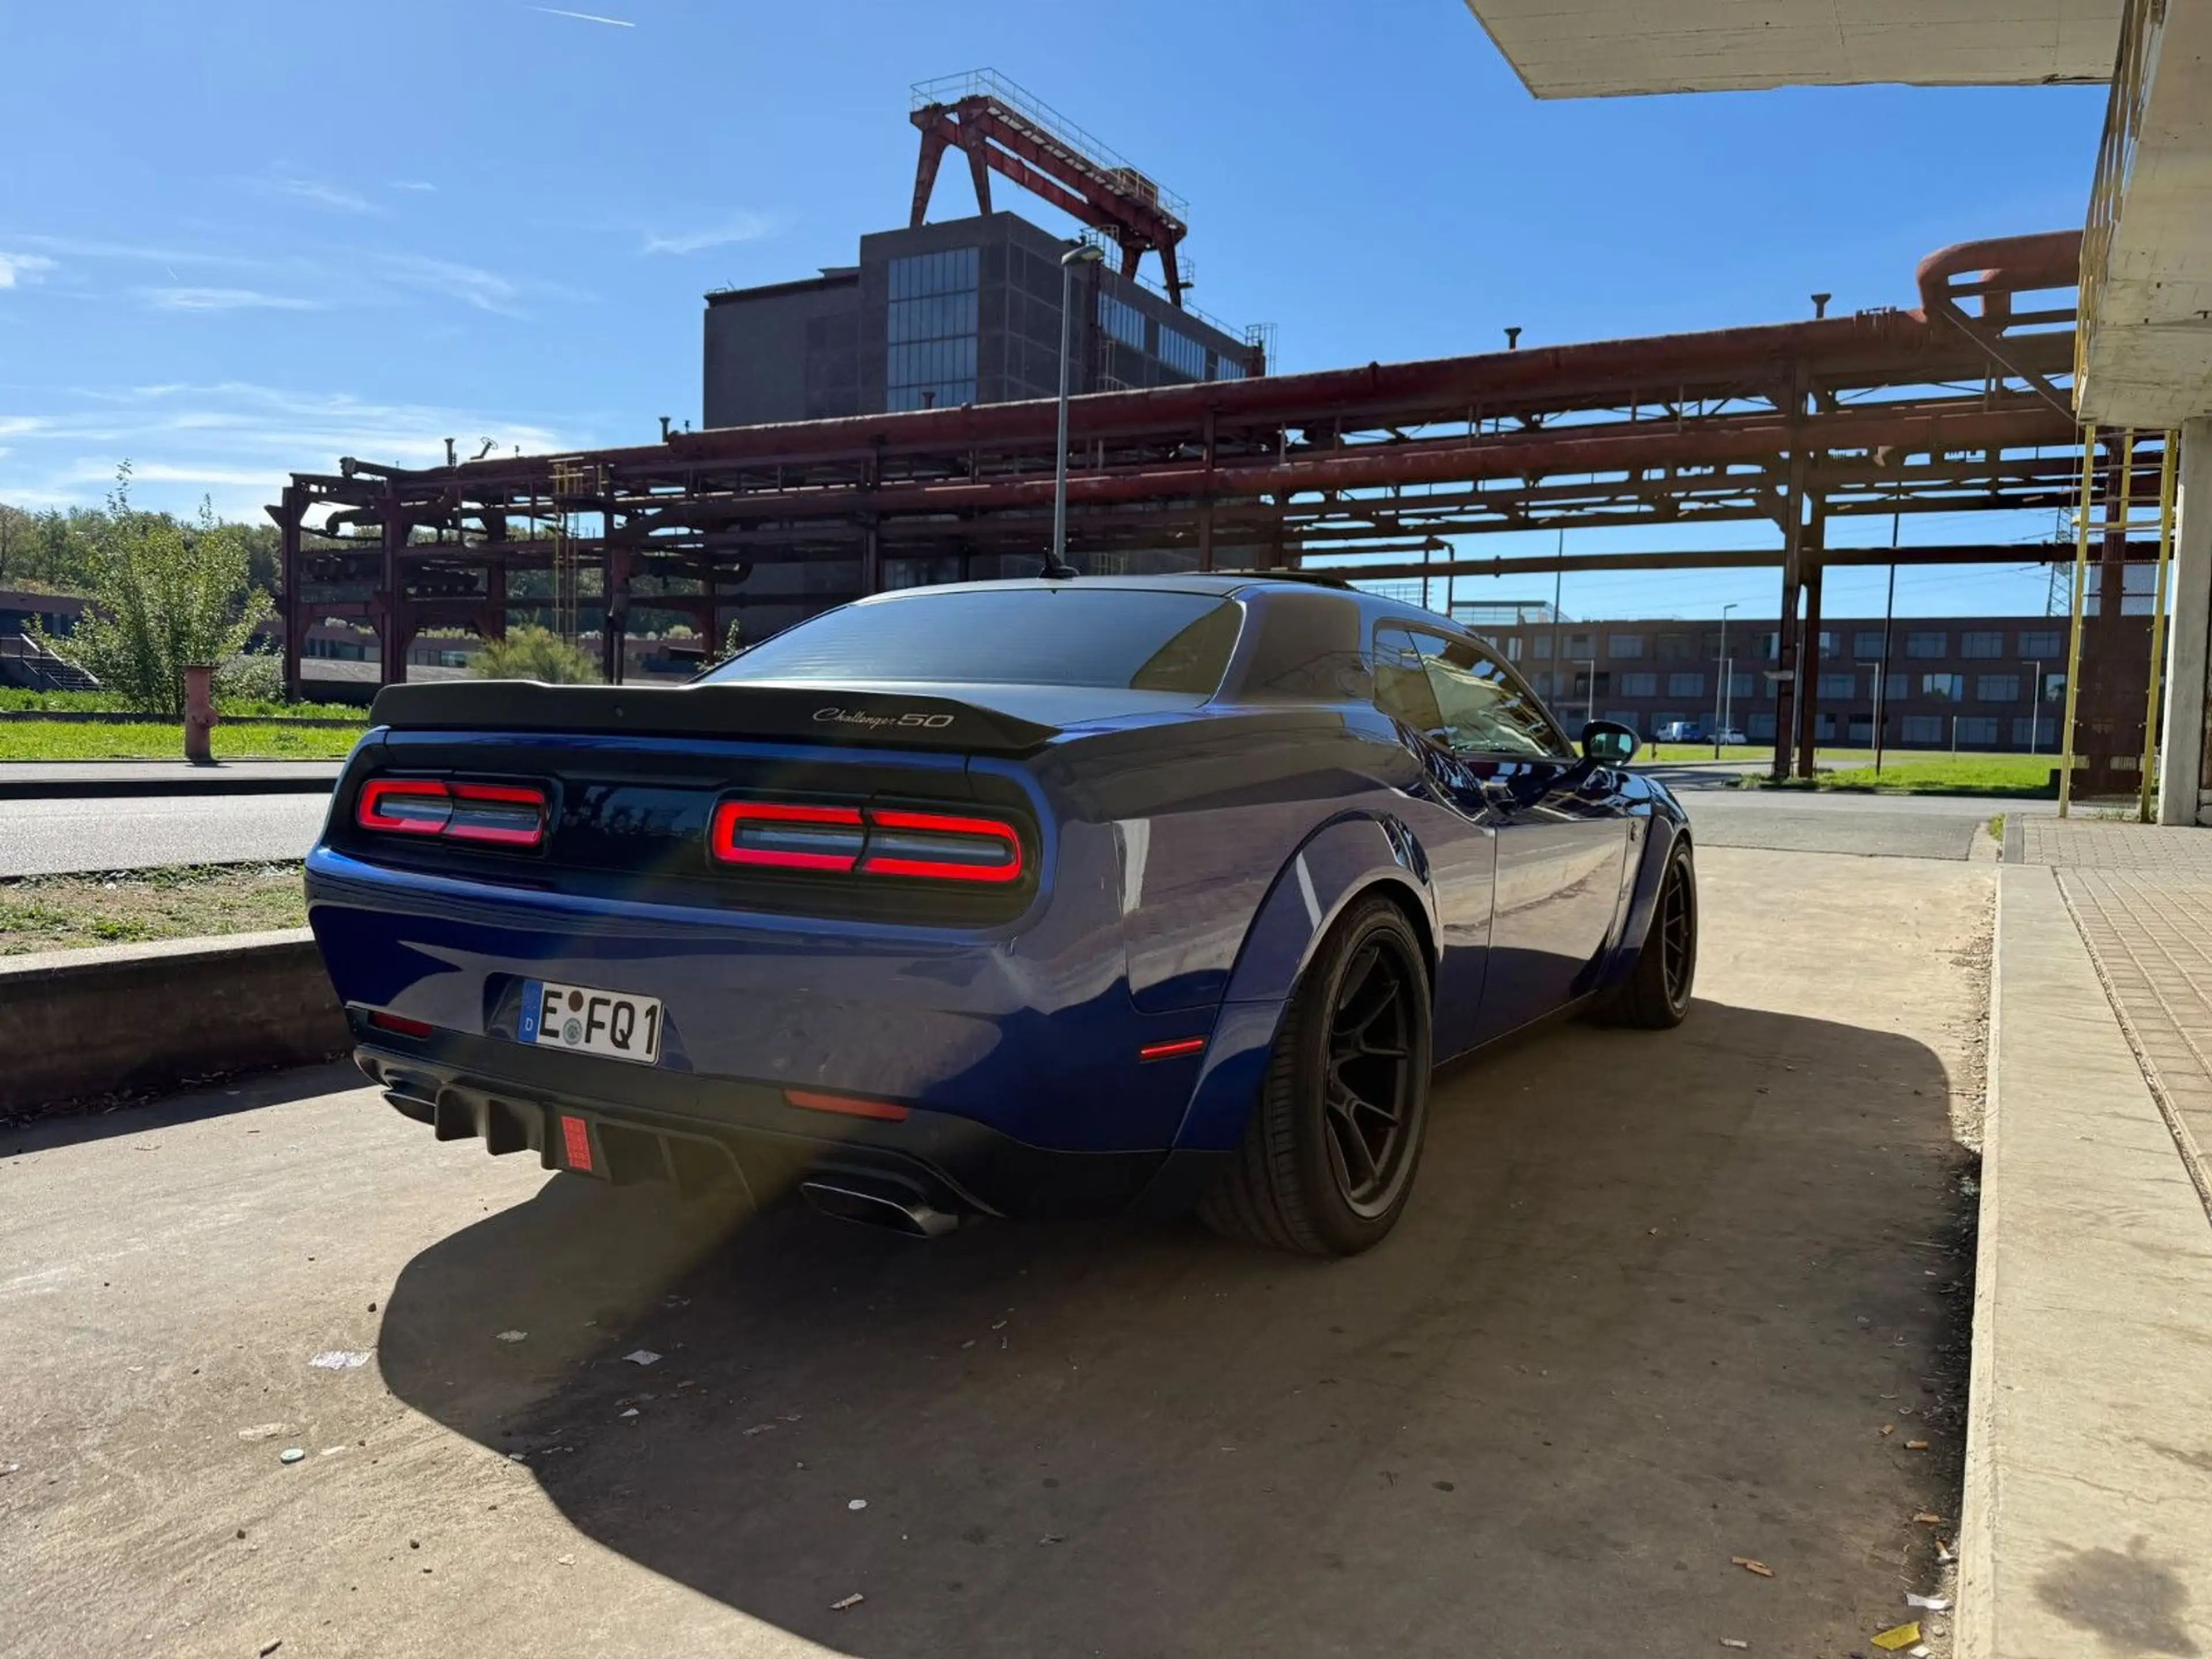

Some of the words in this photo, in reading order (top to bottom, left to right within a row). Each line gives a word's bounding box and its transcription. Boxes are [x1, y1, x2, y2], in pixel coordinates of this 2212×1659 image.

[812, 707, 896, 729] Challenger
[897, 713, 955, 728] 50
[525, 1017, 533, 1031] D
[539, 990, 563, 1039] E
